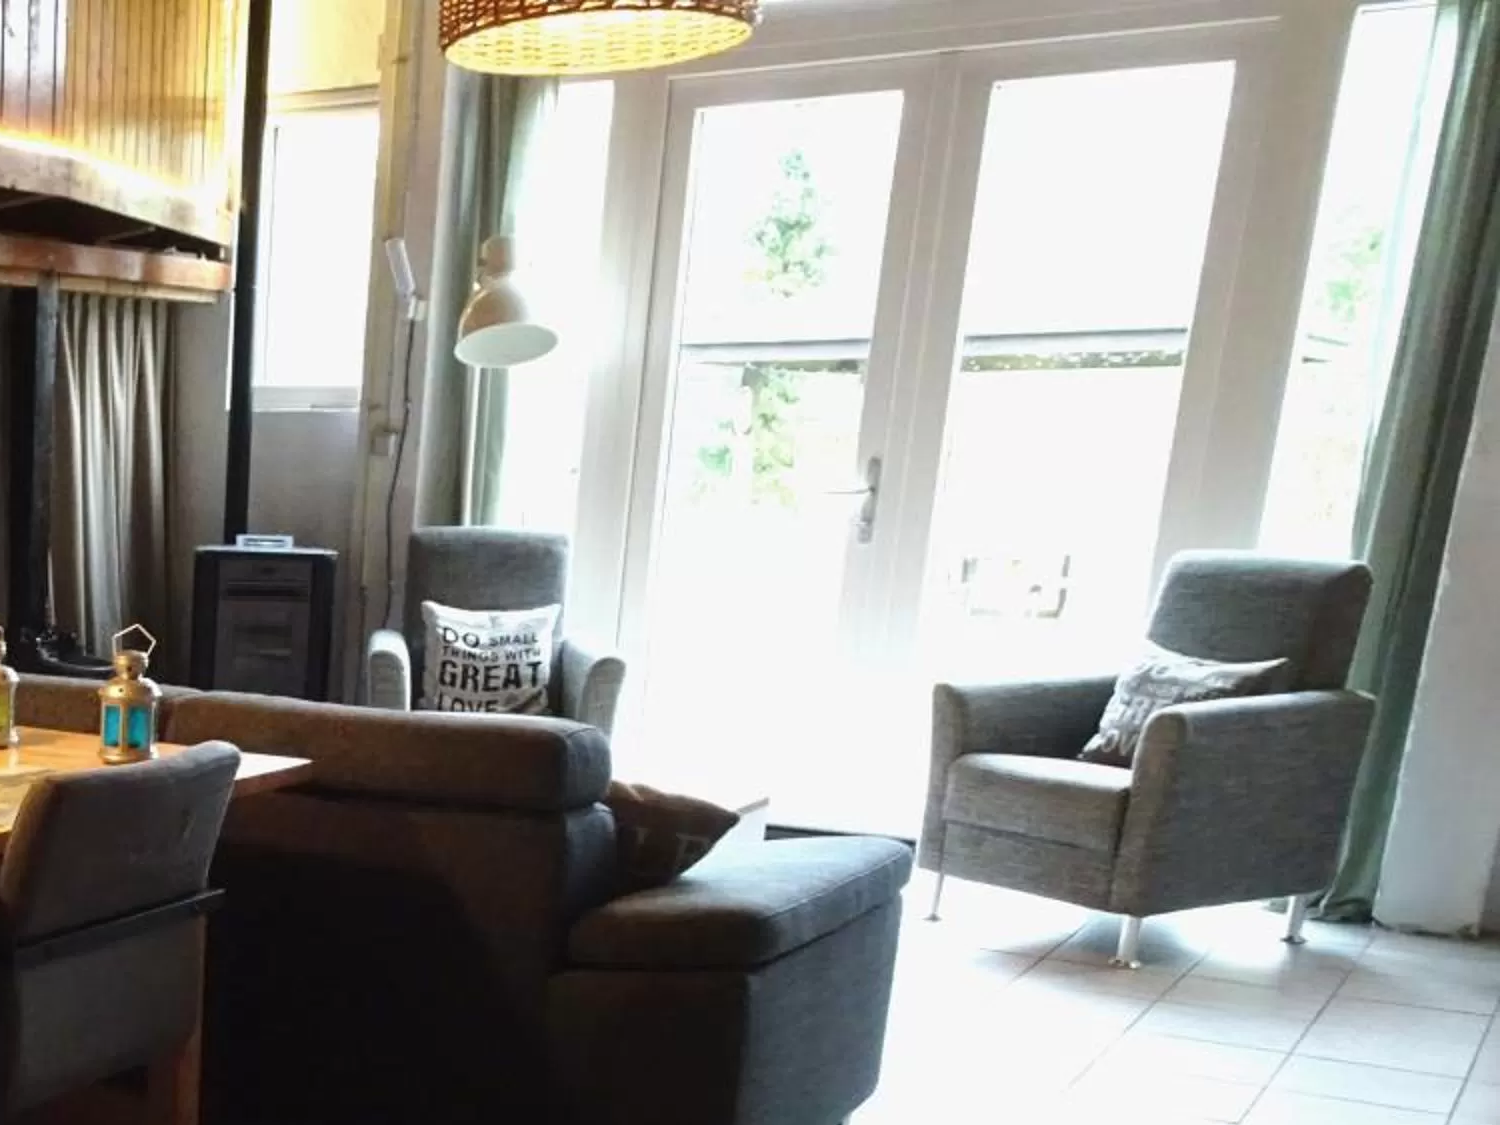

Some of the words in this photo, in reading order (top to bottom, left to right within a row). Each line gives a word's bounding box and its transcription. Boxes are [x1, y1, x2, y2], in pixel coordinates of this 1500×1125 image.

[443, 626, 481, 648] DO
[489, 632, 538, 646] SMALL
[443, 645, 499, 661] THINGS
[439, 659, 542, 693] GREAT
